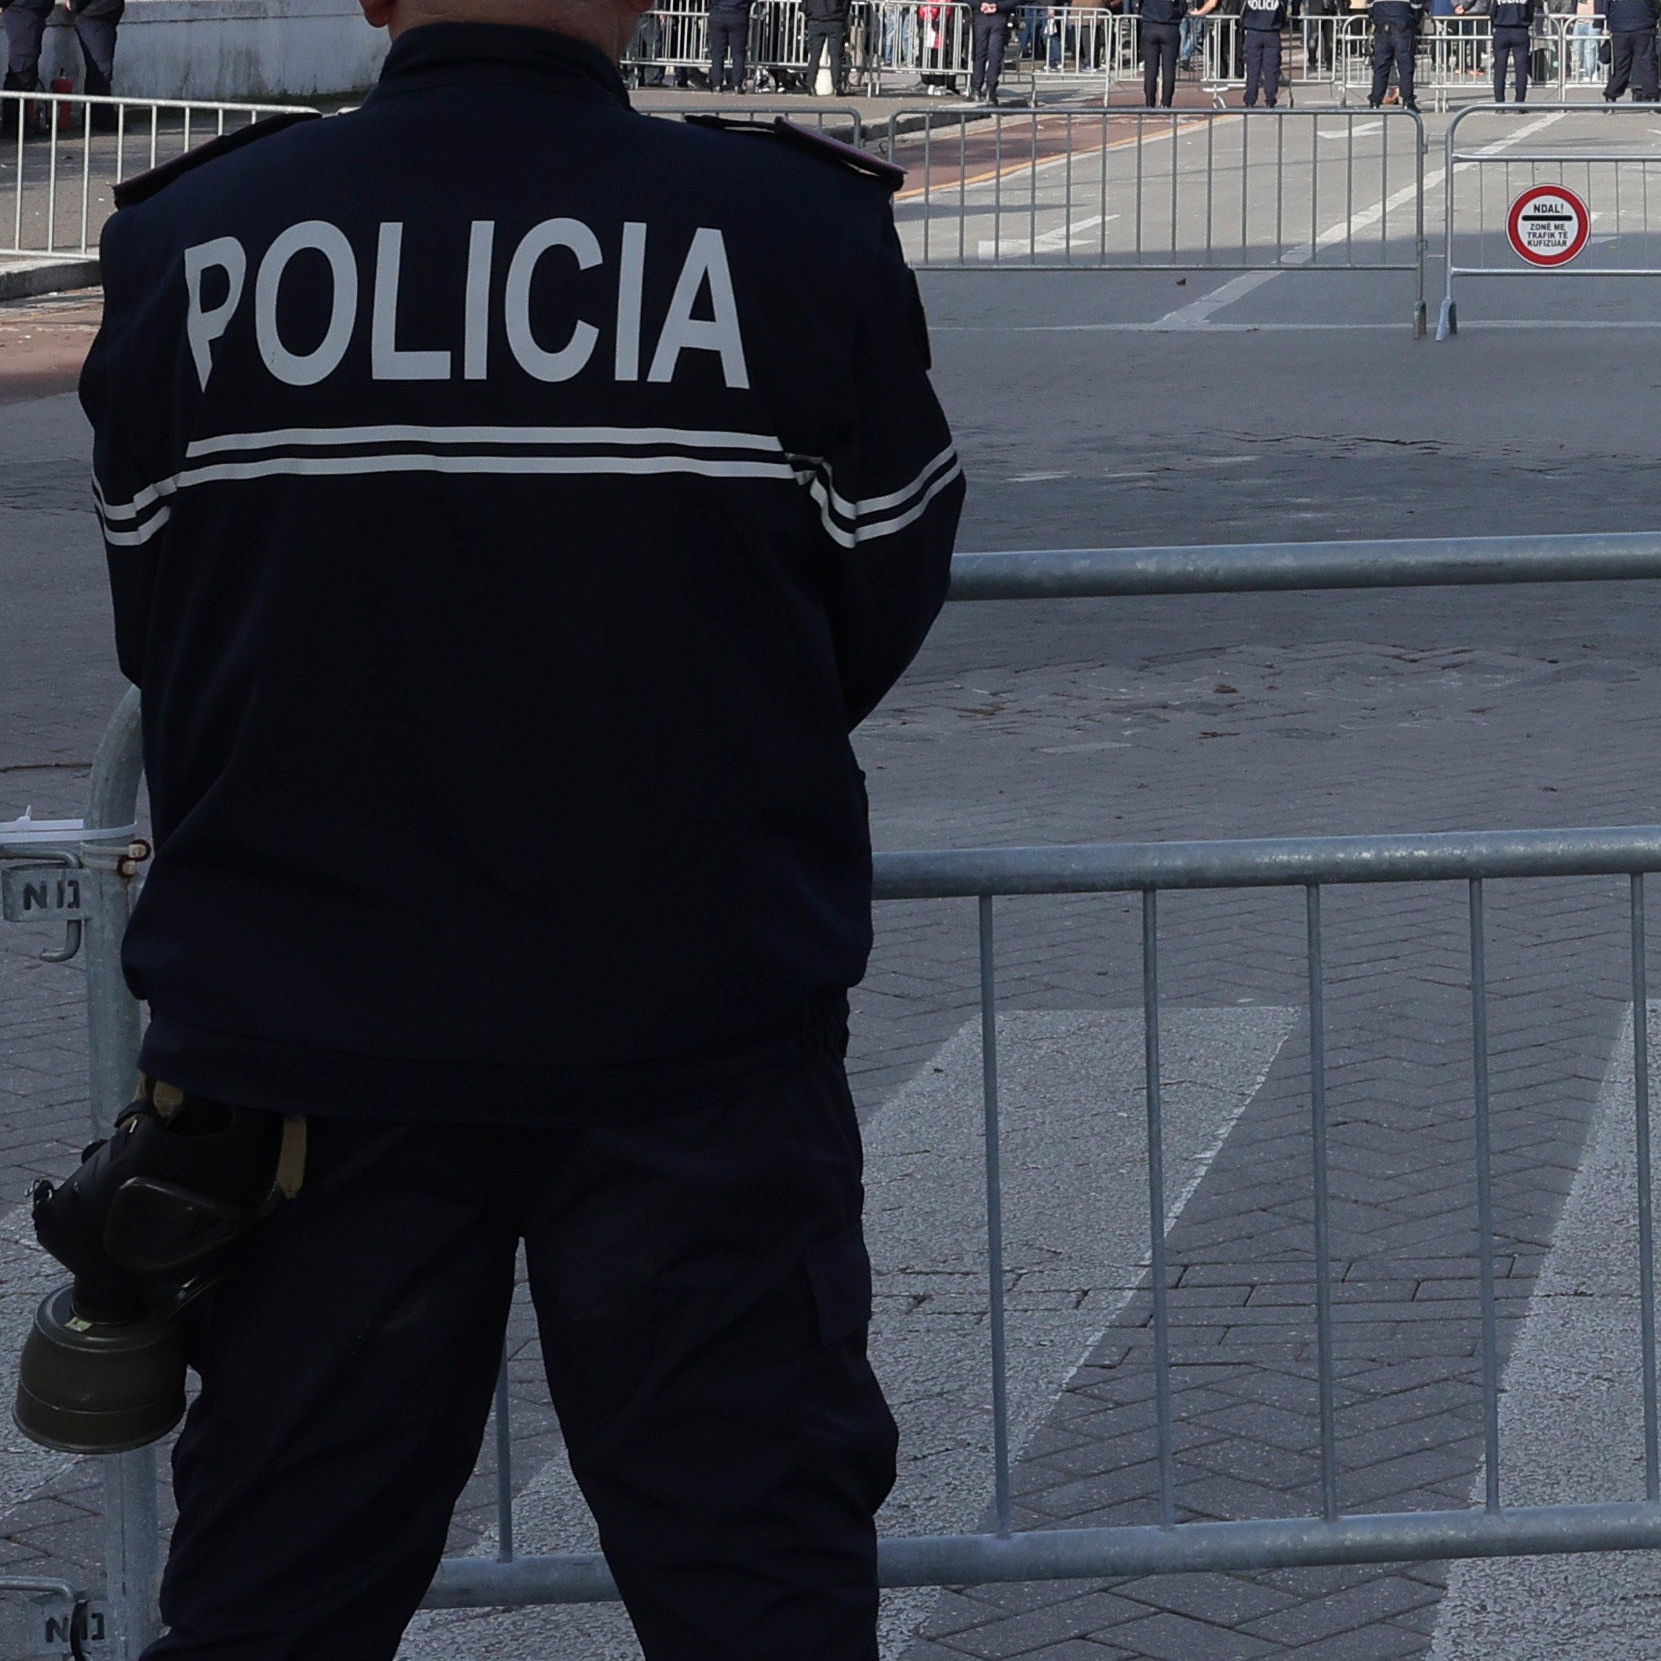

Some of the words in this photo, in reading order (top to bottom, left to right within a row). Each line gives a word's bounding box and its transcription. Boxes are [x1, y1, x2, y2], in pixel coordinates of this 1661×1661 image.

[1533, 204, 1564, 213] NDAL!
[1530, 222, 1551, 231] ZONË
[1554, 223, 1565, 231] ME
[1558, 231, 1568, 239] TË
[184, 217, 750, 393] POLICIA
